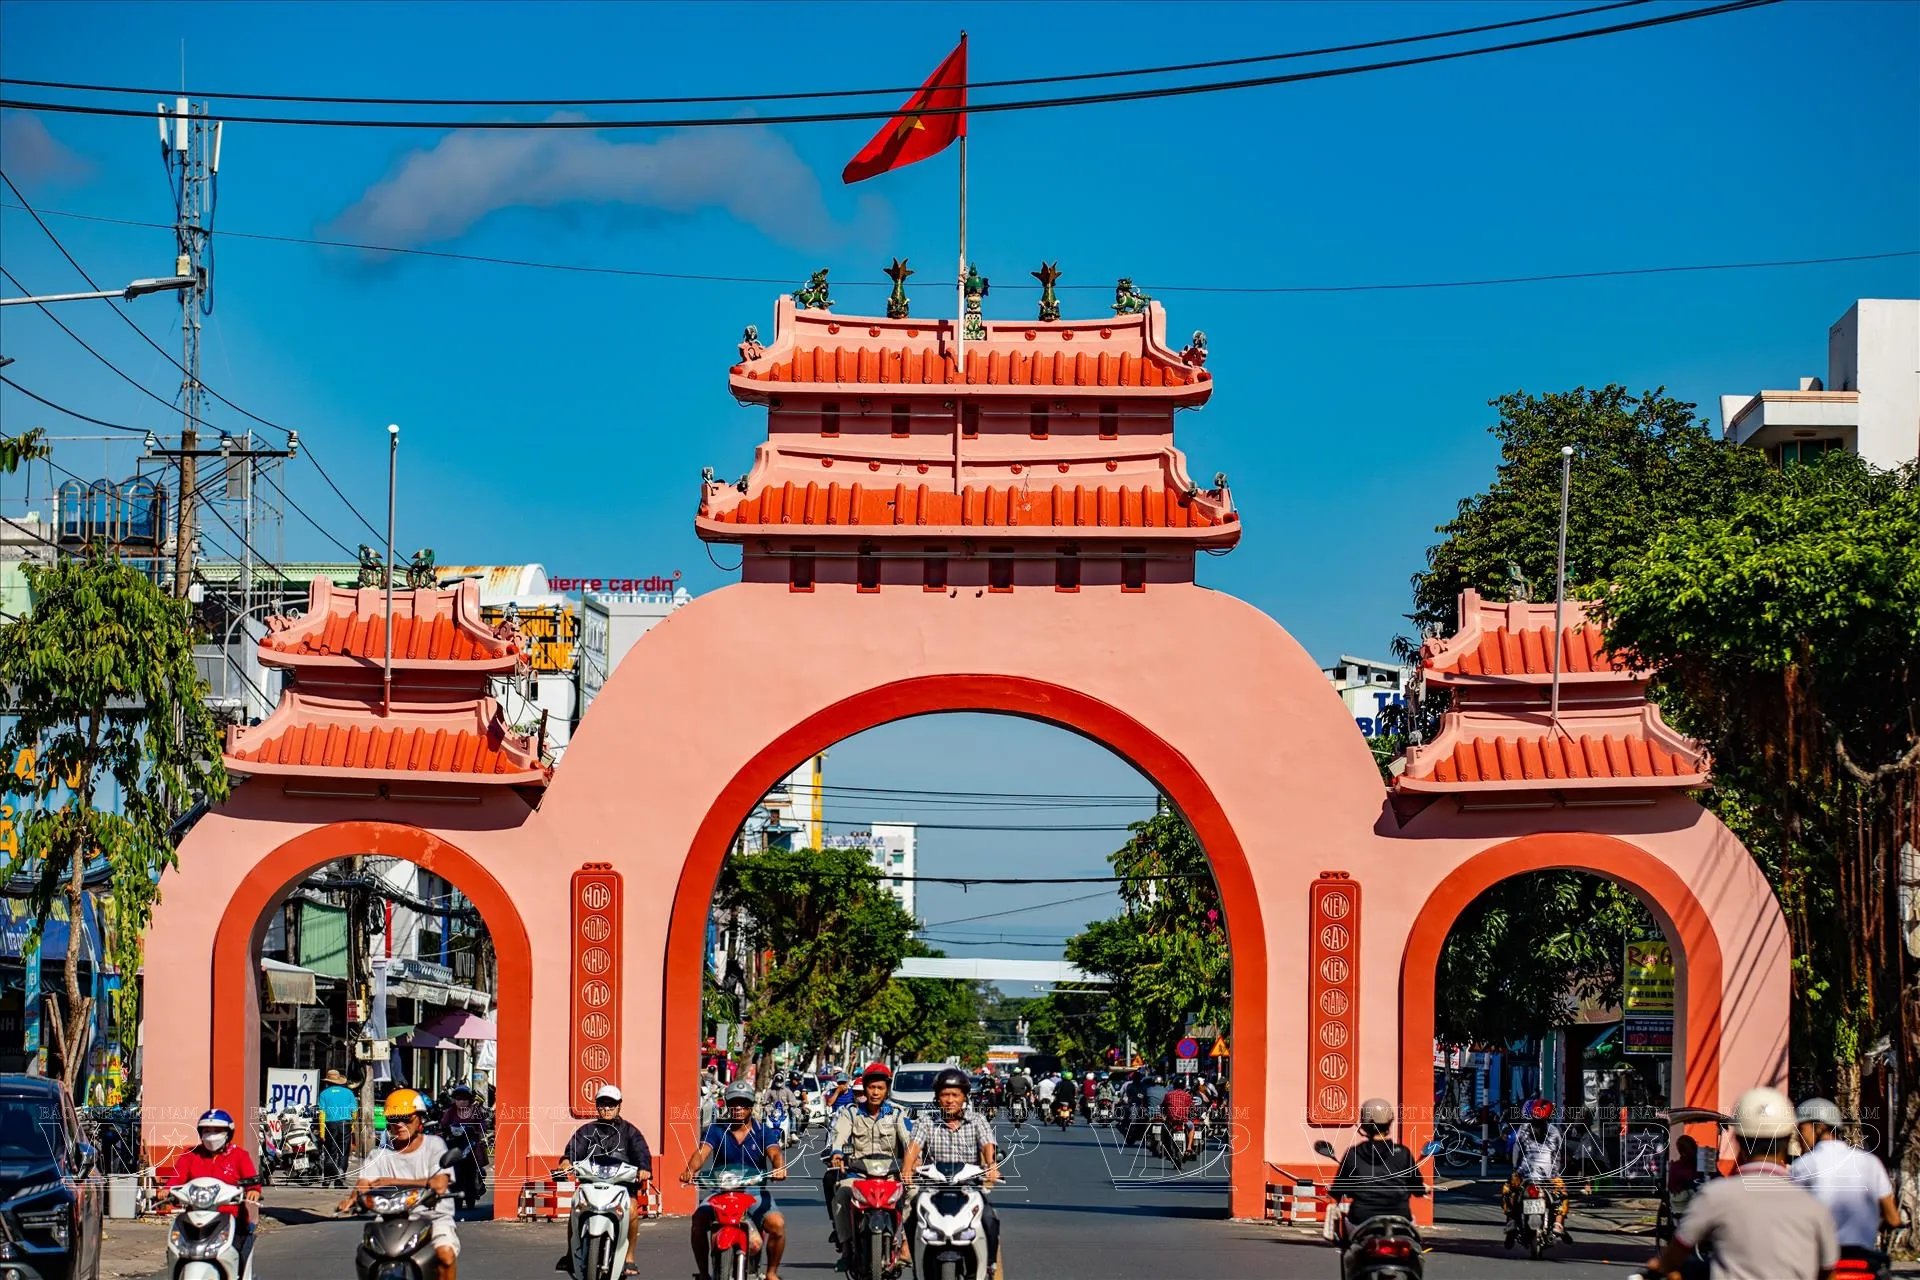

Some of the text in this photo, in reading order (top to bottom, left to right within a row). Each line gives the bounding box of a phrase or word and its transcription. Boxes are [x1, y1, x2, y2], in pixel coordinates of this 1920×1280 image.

[608, 575, 673, 592] cardin
[532, 642, 574, 671] CLINIC
[269, 1073, 312, 1114] PHỞ
